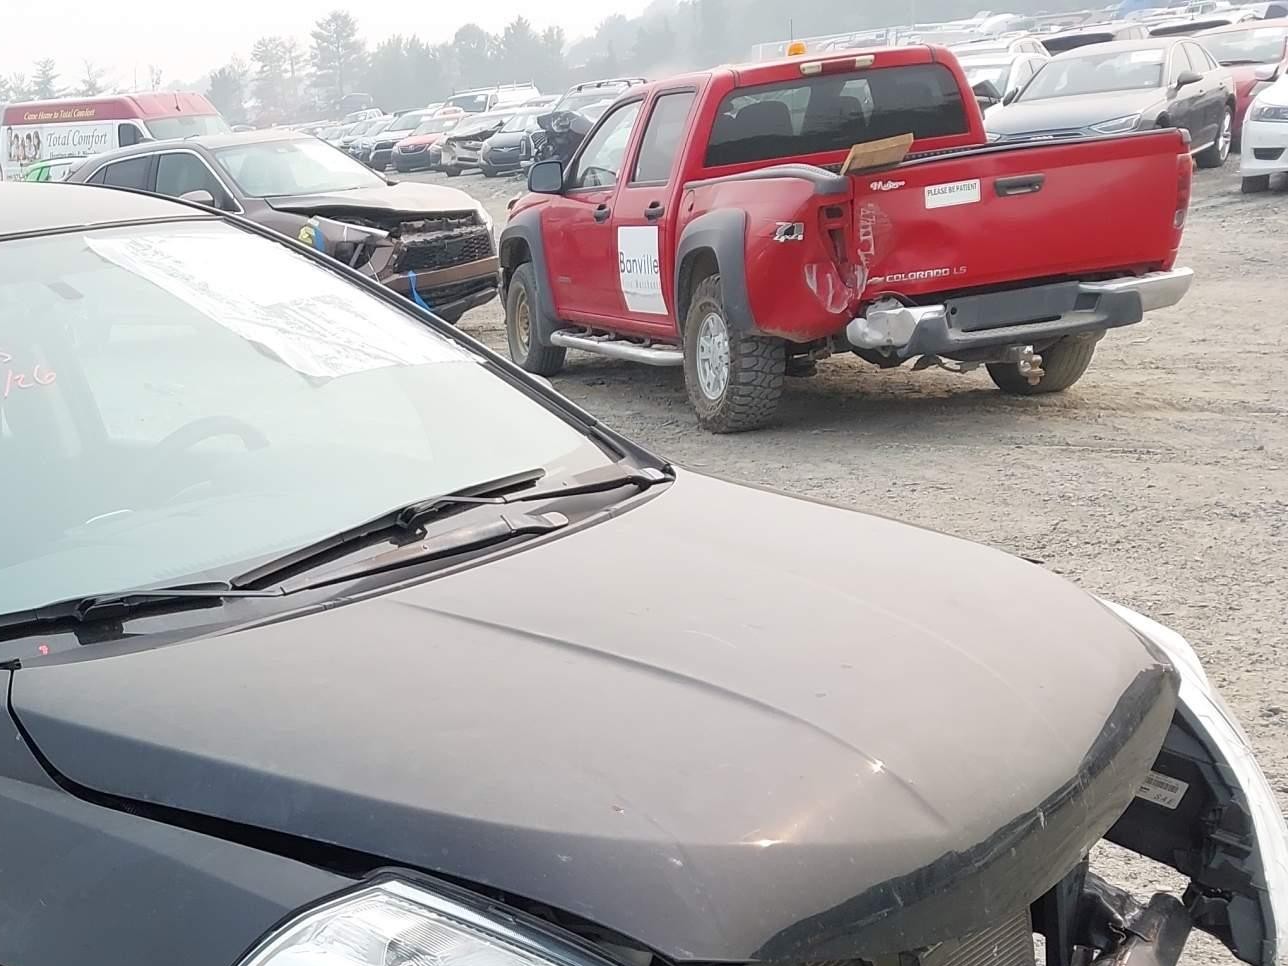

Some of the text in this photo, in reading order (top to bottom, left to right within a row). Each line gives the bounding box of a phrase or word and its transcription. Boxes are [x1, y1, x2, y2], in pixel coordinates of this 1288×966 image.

[38, 111, 53, 120] Home
[59, 109, 73, 119] Total
[73, 108, 95, 118] Comfort
[47, 129, 108, 149] Total Comfort
[927, 182, 977, 197] PLEASE BE PATIENT
[619, 251, 659, 275] Banville
[886, 266, 967, 283] COLORADO LS
